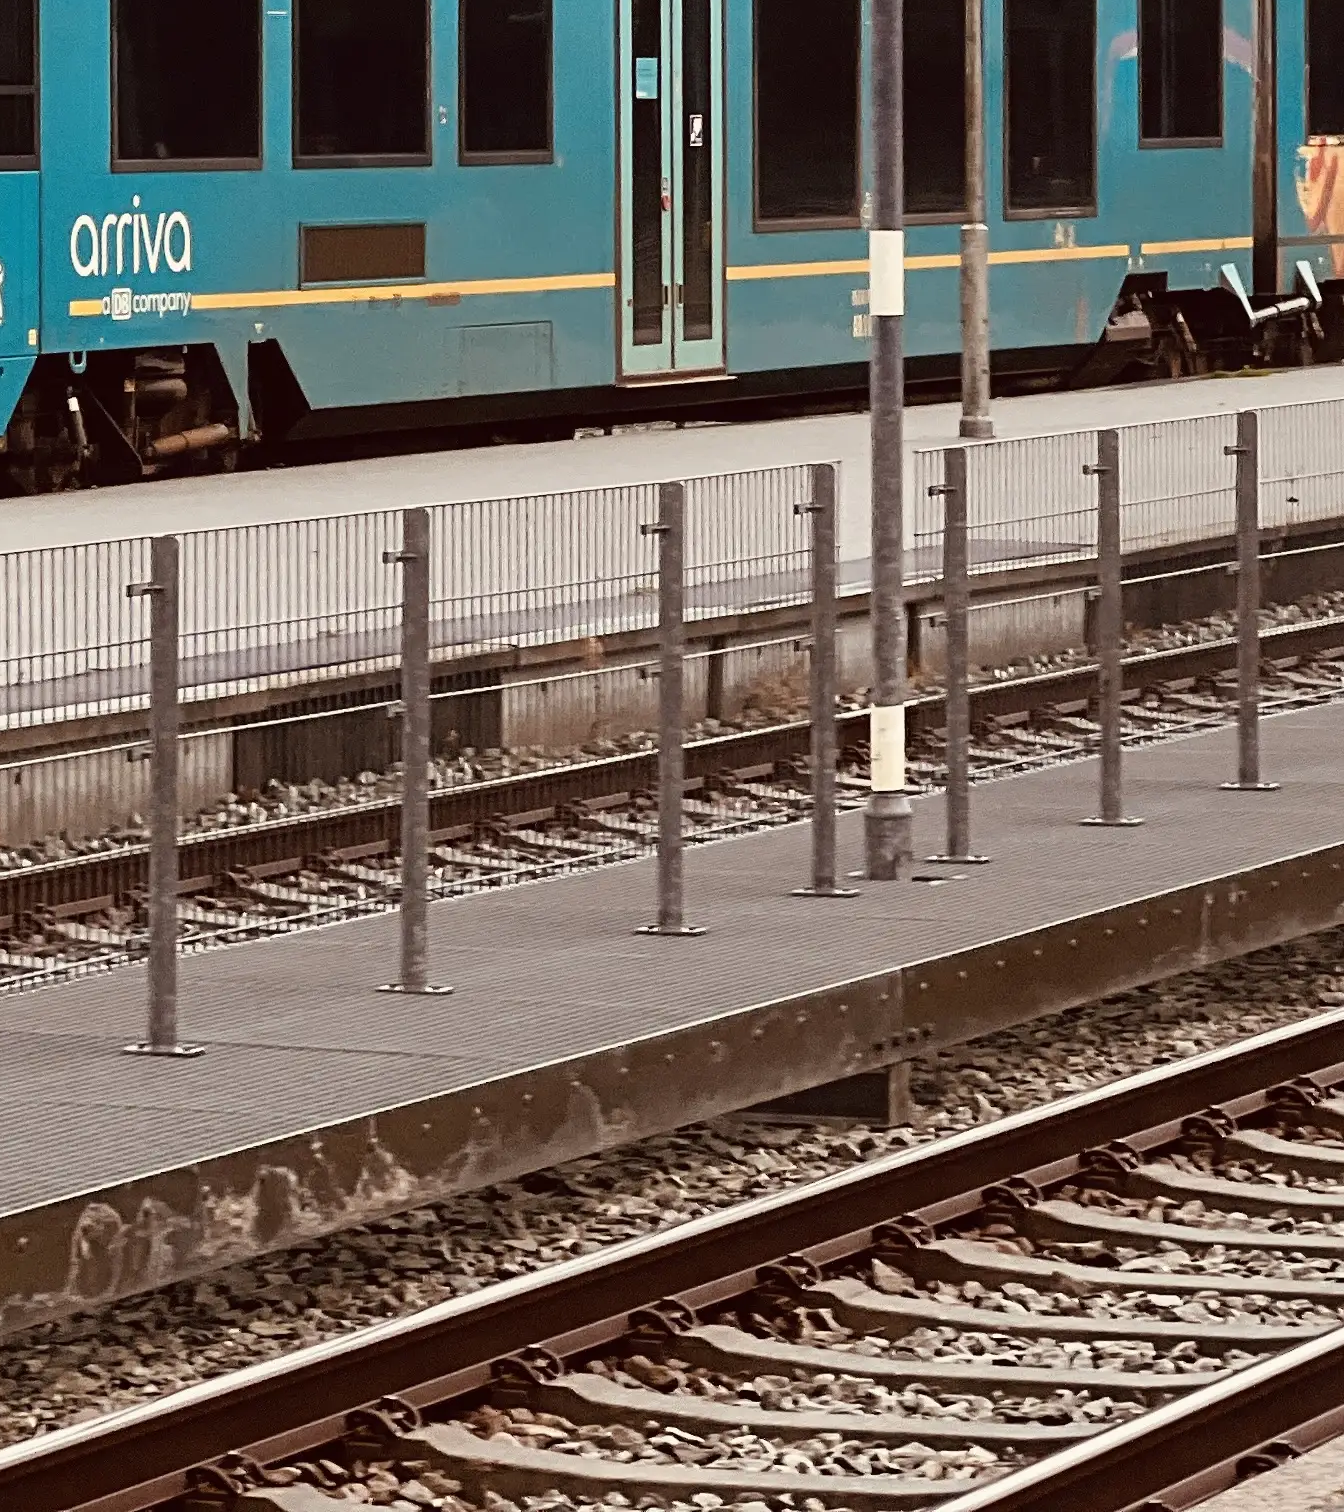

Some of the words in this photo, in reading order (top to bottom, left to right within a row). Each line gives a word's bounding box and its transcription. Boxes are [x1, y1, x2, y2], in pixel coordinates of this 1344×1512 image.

[69, 195, 193, 278] arriva
[102, 296, 111, 316] a
[113, 290, 131, 318] DB
[132, 291, 192, 319] company
